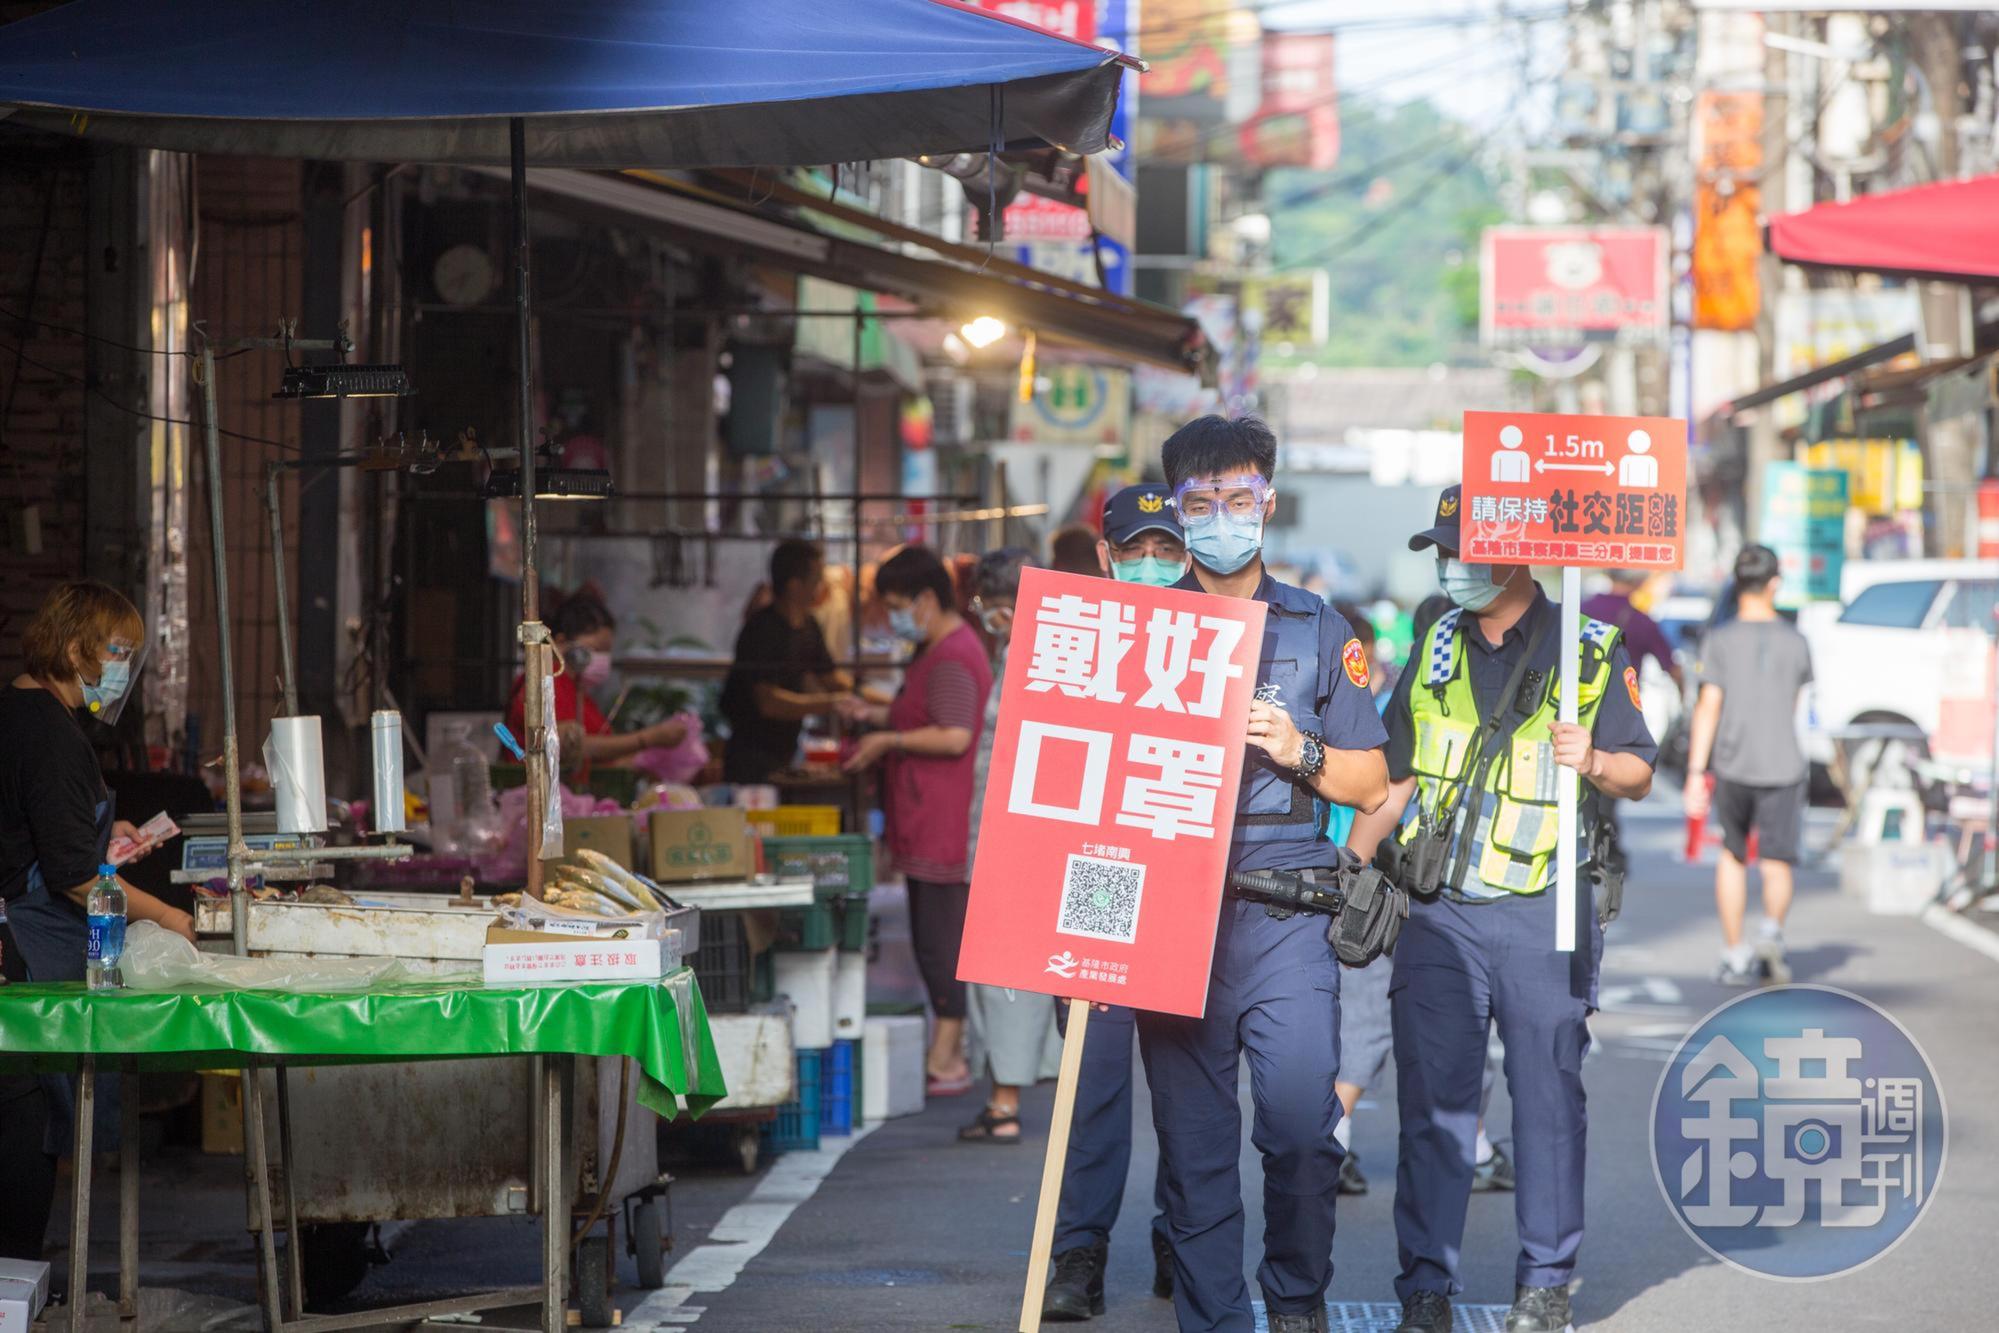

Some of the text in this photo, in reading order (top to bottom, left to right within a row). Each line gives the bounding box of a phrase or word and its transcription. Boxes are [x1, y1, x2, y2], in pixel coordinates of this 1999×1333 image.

[1544, 434, 1605, 459] 1.5m
[1024, 594, 1246, 718] 戴好
[1007, 719, 1226, 841] 口罩
[1081, 841, 1131, 861] 七堵南興
